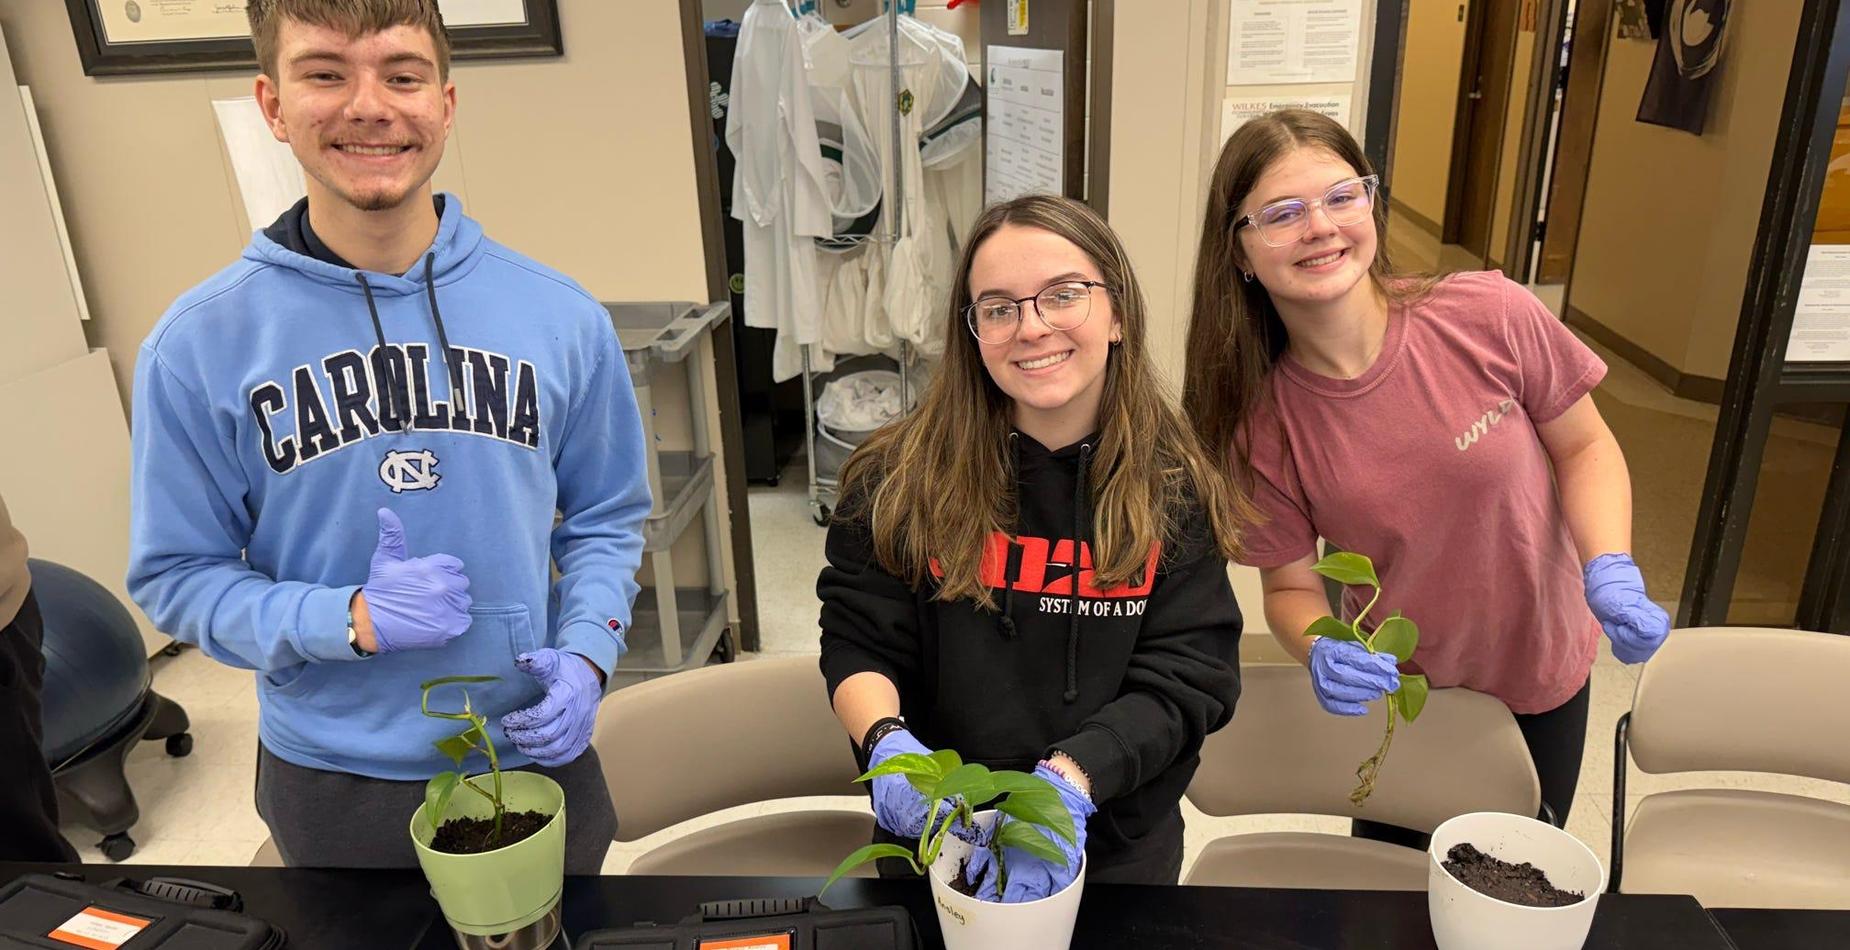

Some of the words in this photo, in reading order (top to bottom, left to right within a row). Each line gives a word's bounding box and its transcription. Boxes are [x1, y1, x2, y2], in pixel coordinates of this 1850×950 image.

[250, 343, 540, 475] CAROLINA
[1039, 597, 1091, 616] SYSTM
[1093, 601, 1111, 616] OF
[1113, 601, 1122, 616] A
